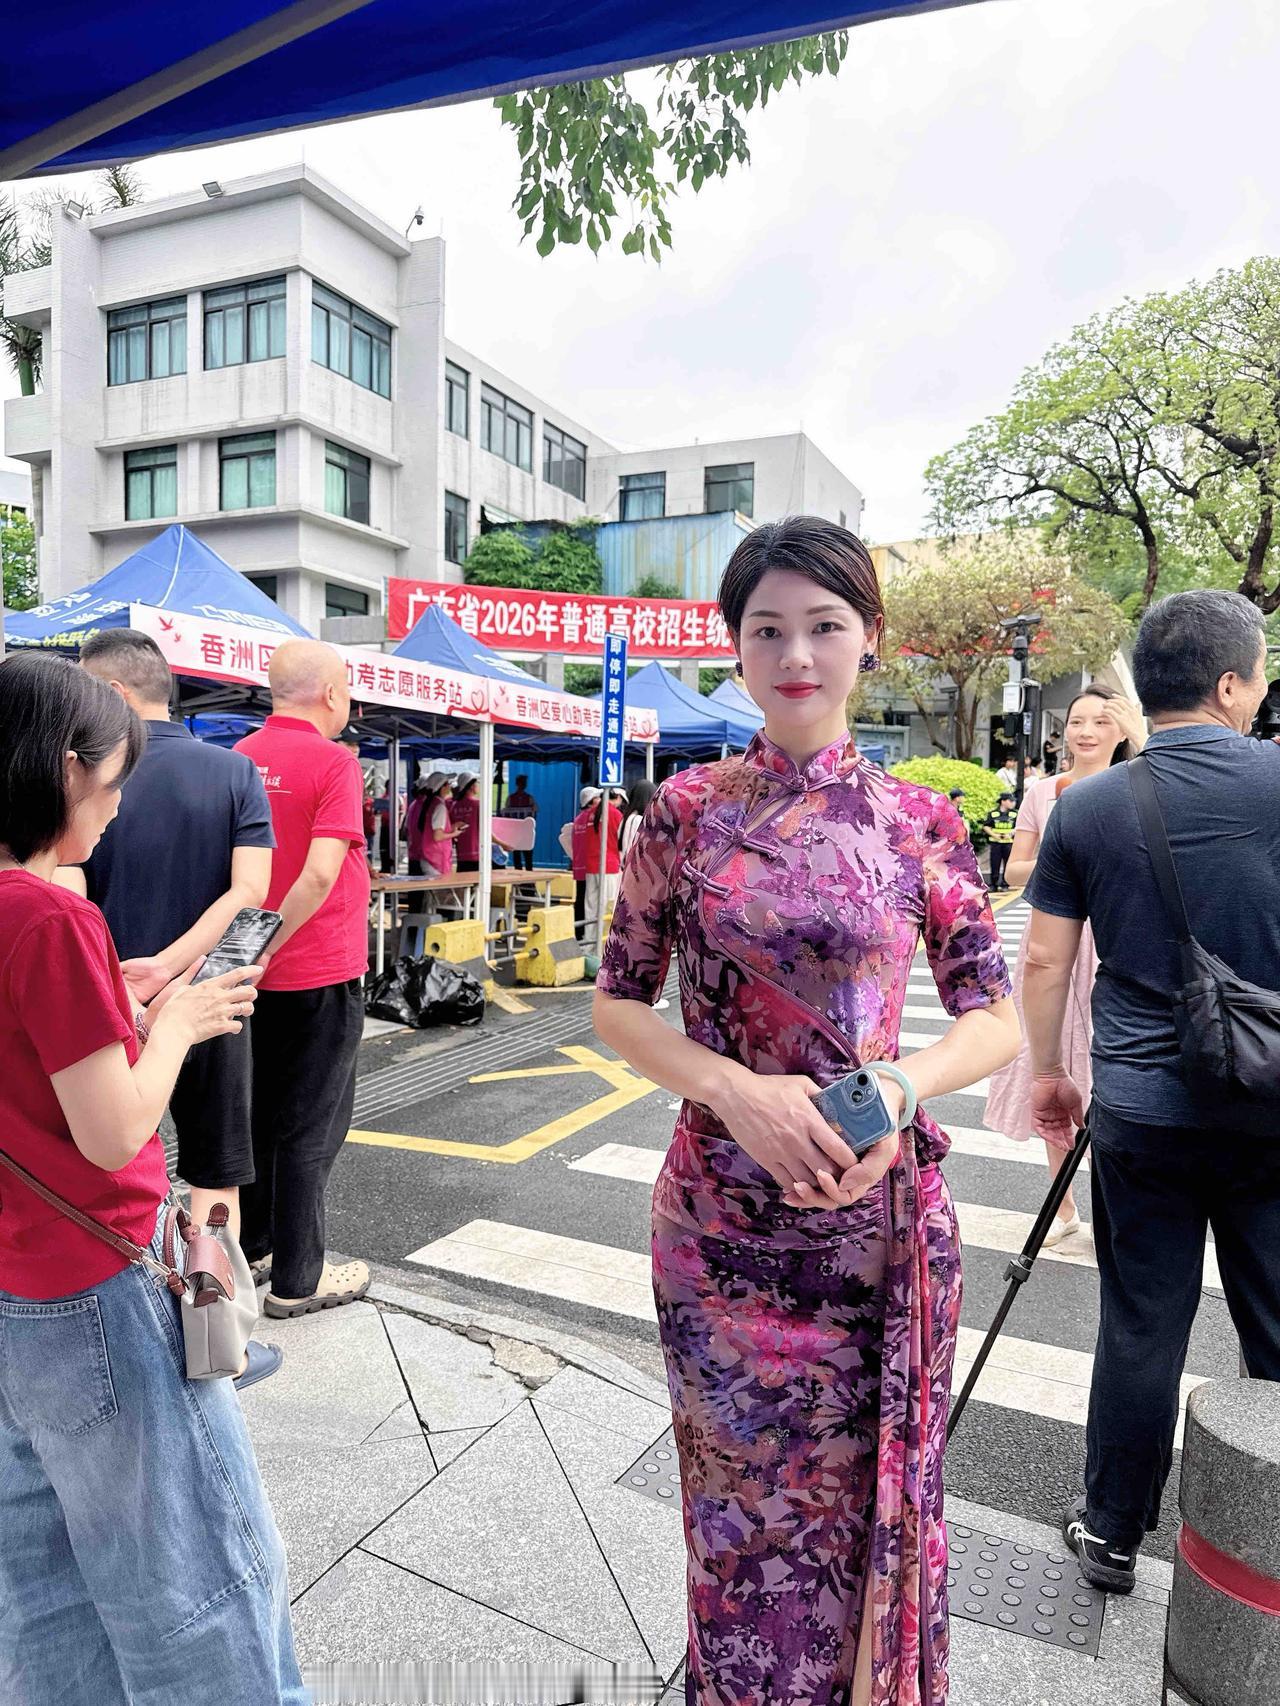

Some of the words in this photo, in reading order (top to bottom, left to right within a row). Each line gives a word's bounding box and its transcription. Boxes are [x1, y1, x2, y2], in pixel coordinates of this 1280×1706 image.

[200, 633, 462, 705] 香洲区考志愿服务站
[606, 638, 622, 754] 即停即走通道
